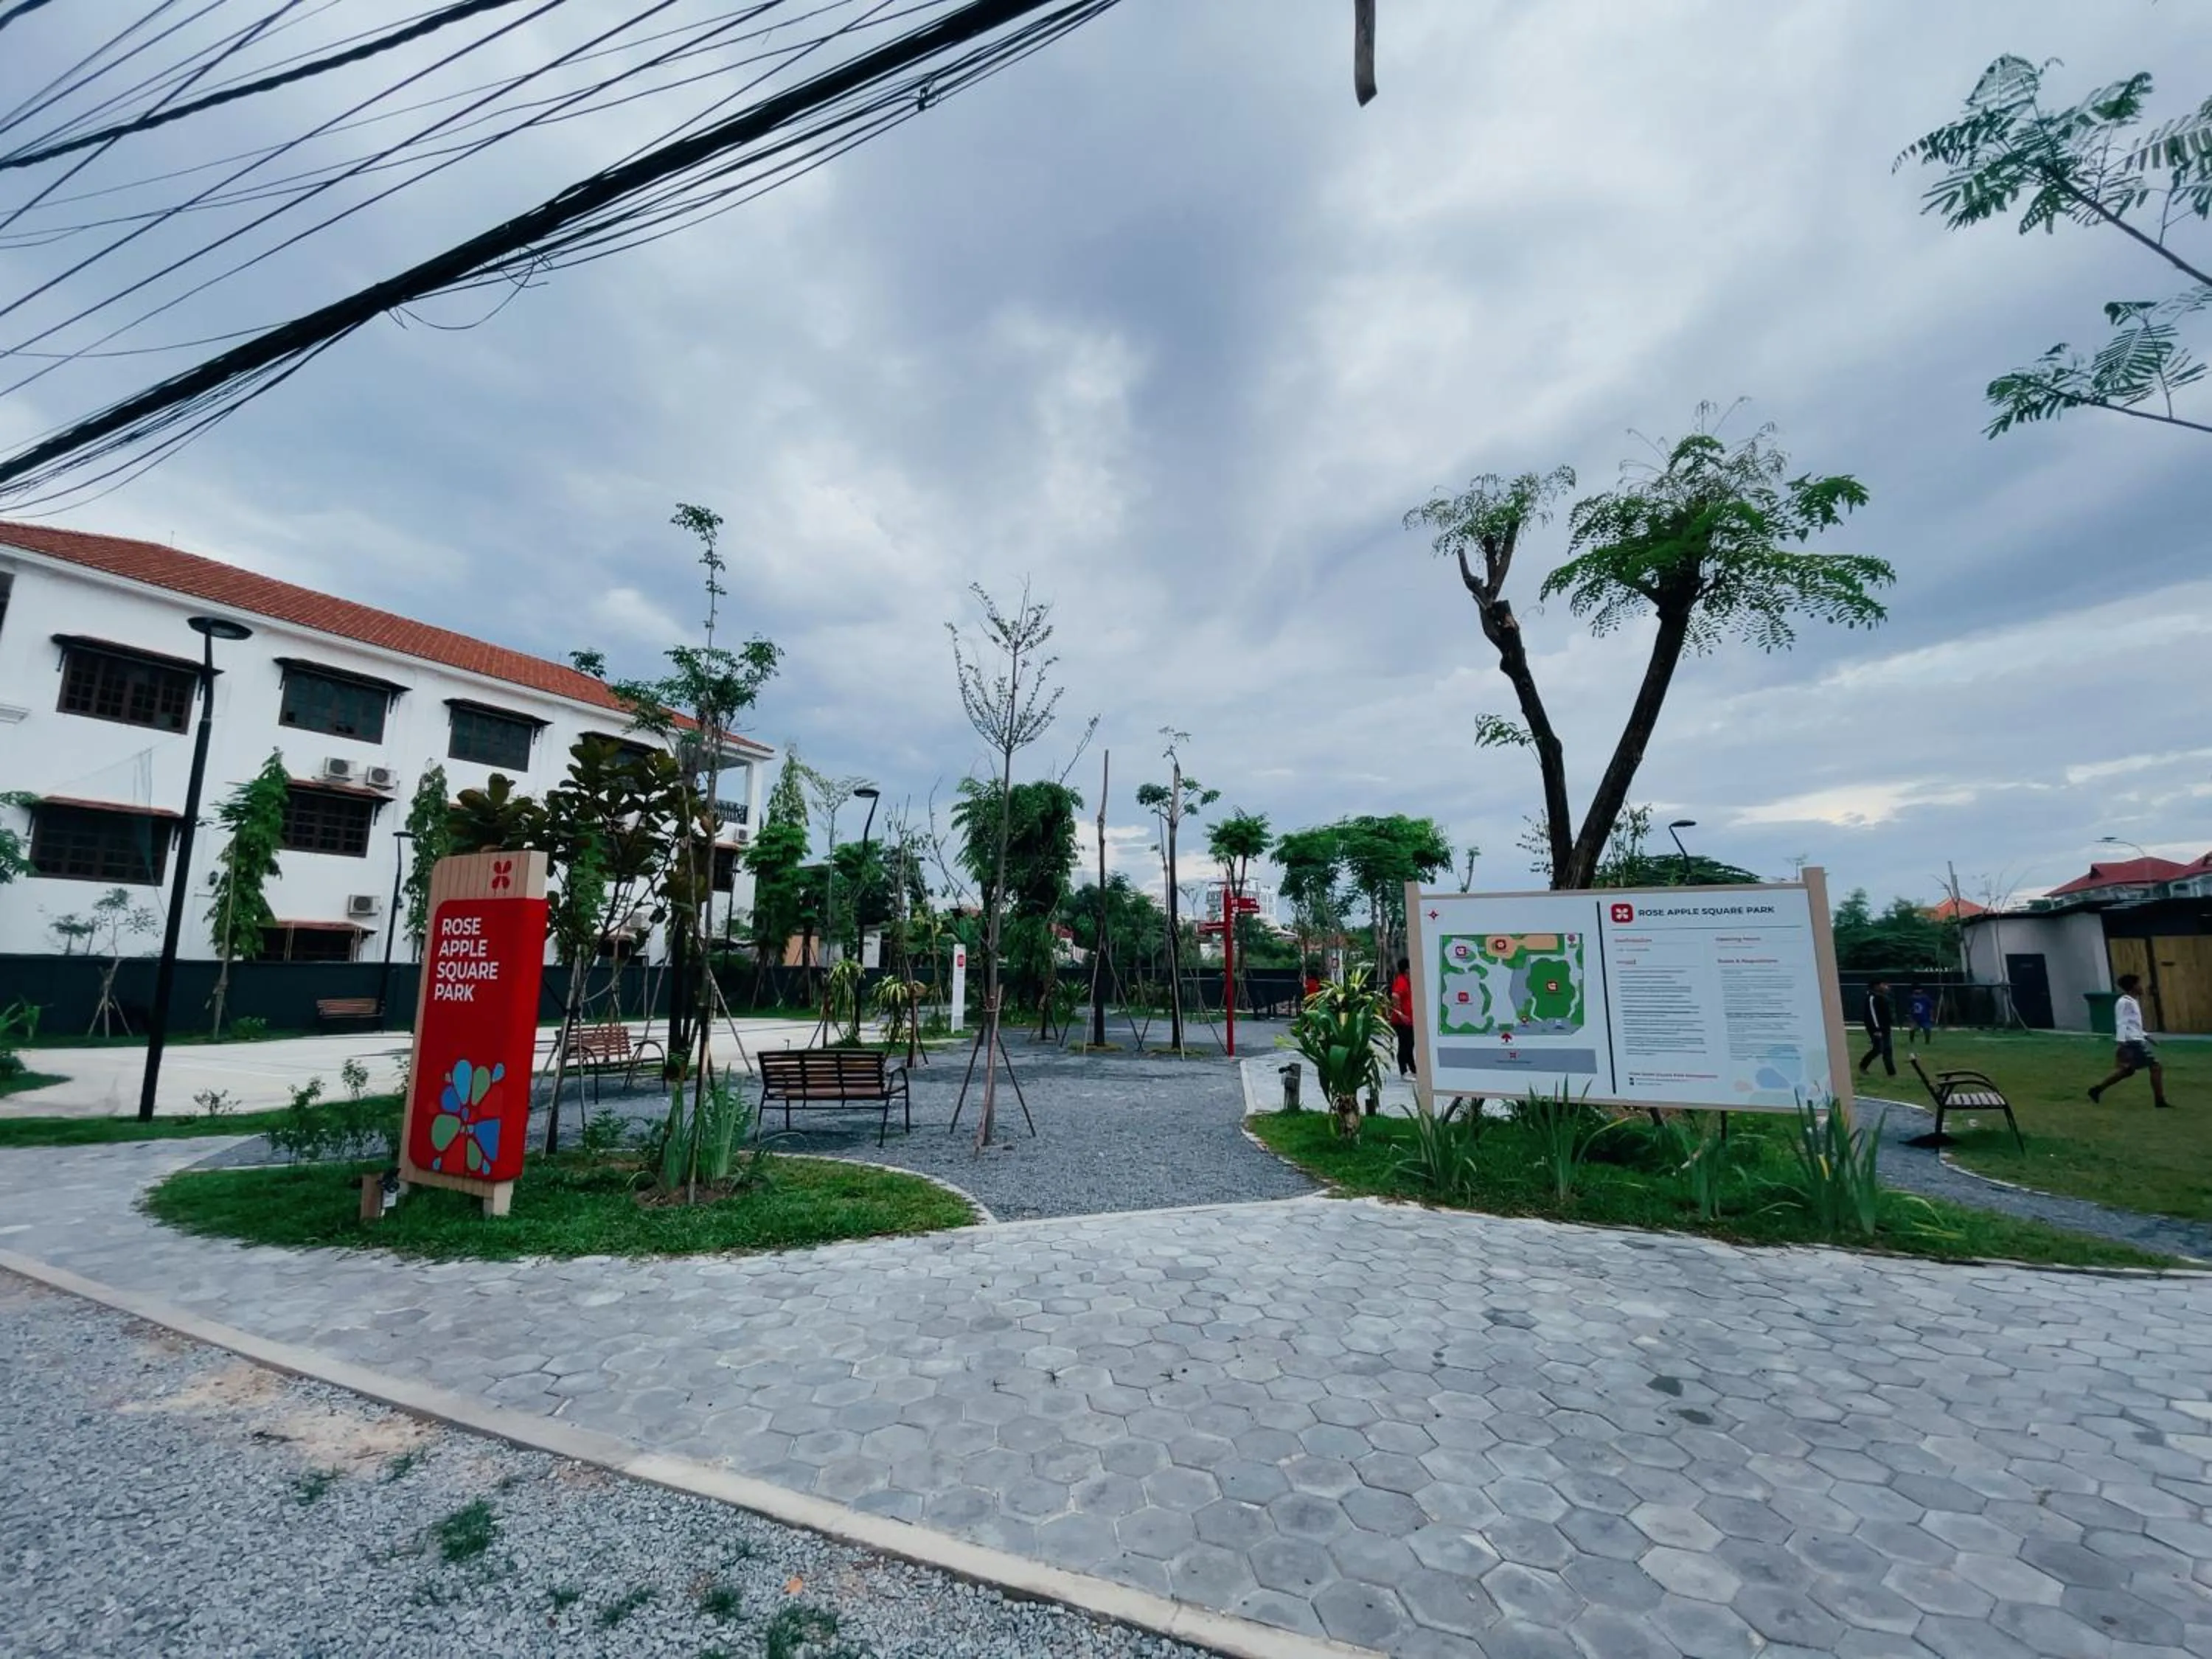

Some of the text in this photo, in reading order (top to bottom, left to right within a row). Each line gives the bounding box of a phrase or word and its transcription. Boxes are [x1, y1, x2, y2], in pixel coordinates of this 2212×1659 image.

[1638, 905, 1775, 917] ROSE APPLE SQUARE PARK
[442, 917, 481, 936] ROSE
[438, 939, 488, 957] APPLE
[437, 961, 499, 982] SQUARE
[434, 983, 476, 1001] PARK
